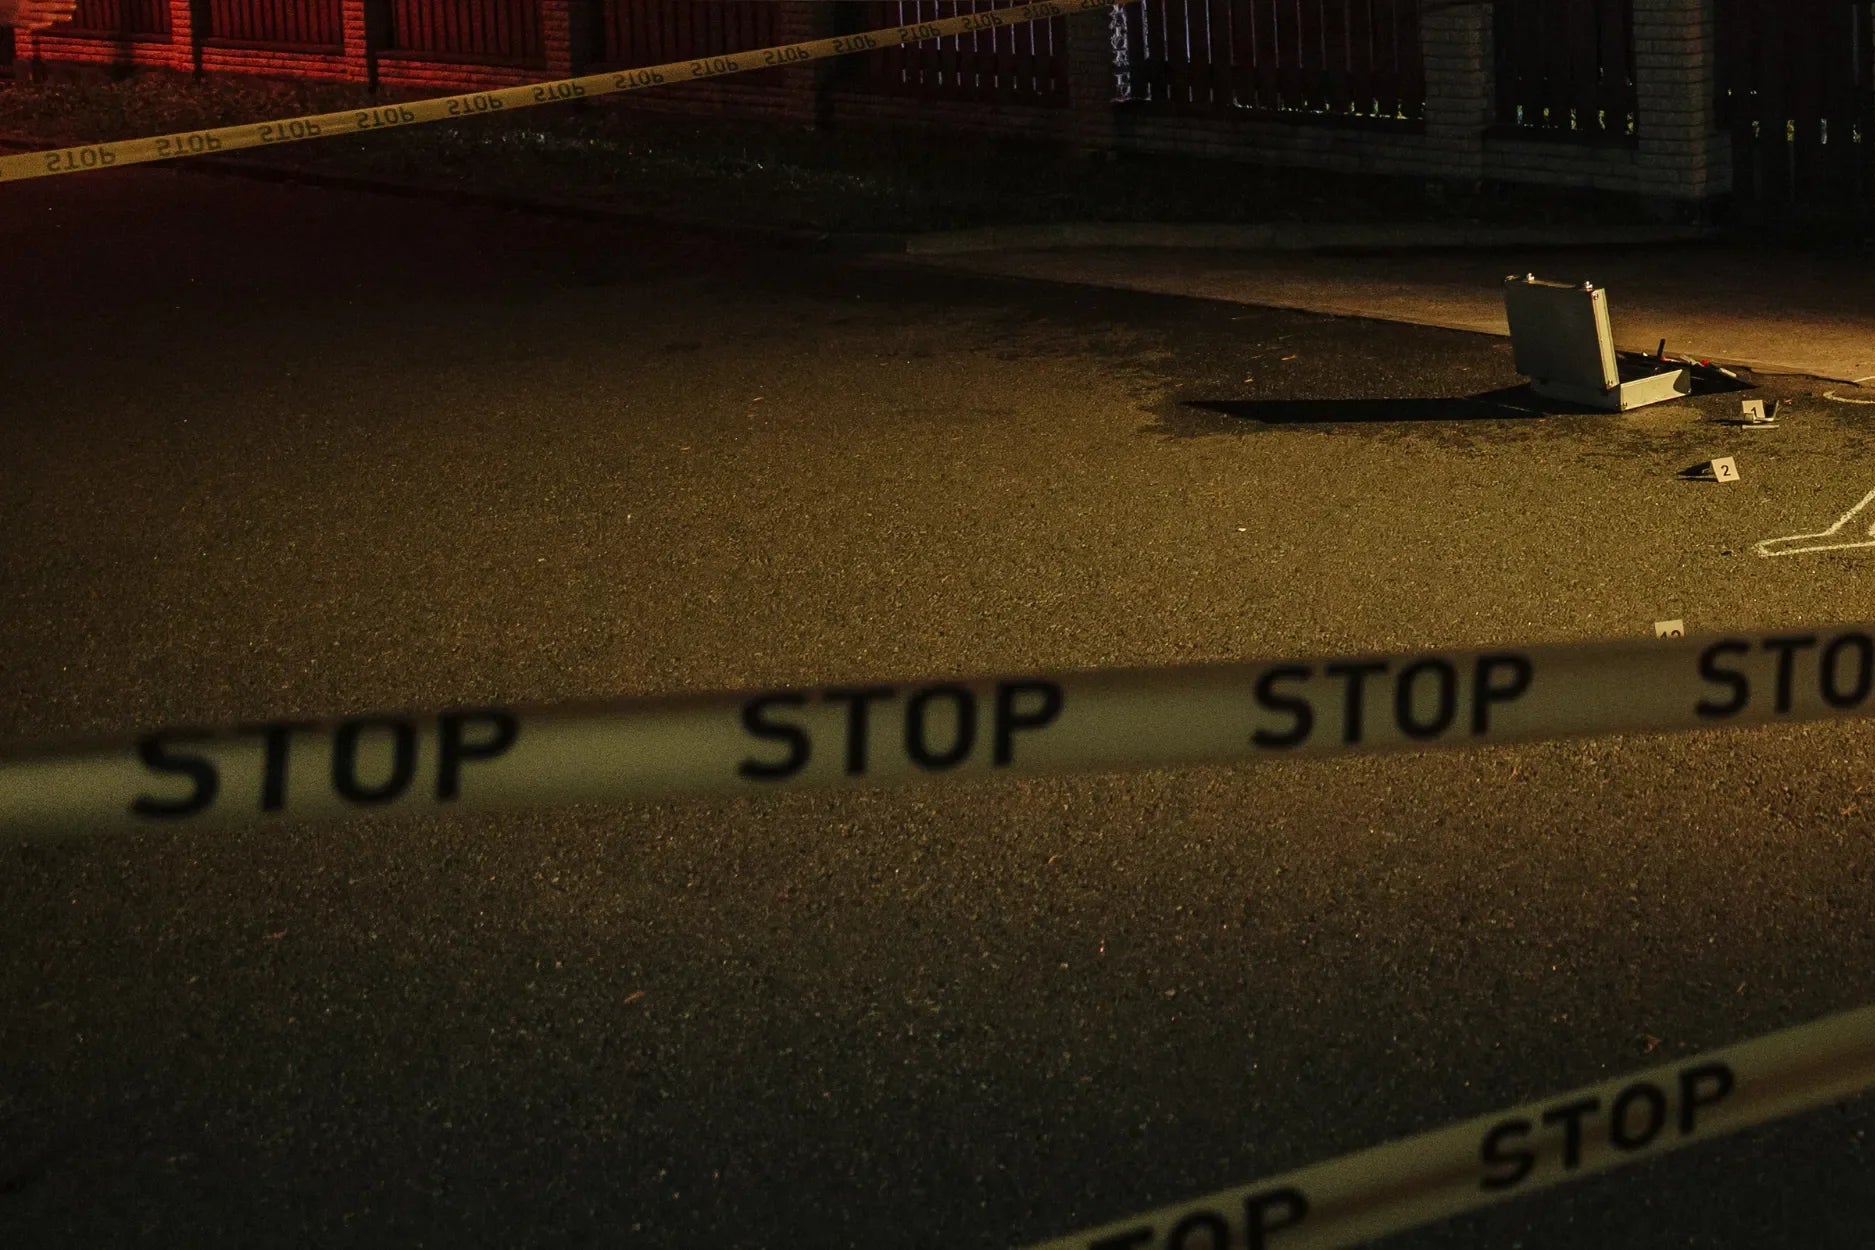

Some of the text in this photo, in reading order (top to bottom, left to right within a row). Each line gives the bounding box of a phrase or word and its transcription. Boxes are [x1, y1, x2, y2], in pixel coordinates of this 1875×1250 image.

[1721, 465, 1731, 476] 2
[130, 710, 519, 818] STOP
[739, 679, 1064, 780] STOP
[1251, 655, 1533, 750] STOP
[1089, 1188, 1309, 1250] OP
[1476, 1061, 1734, 1191] STOP
